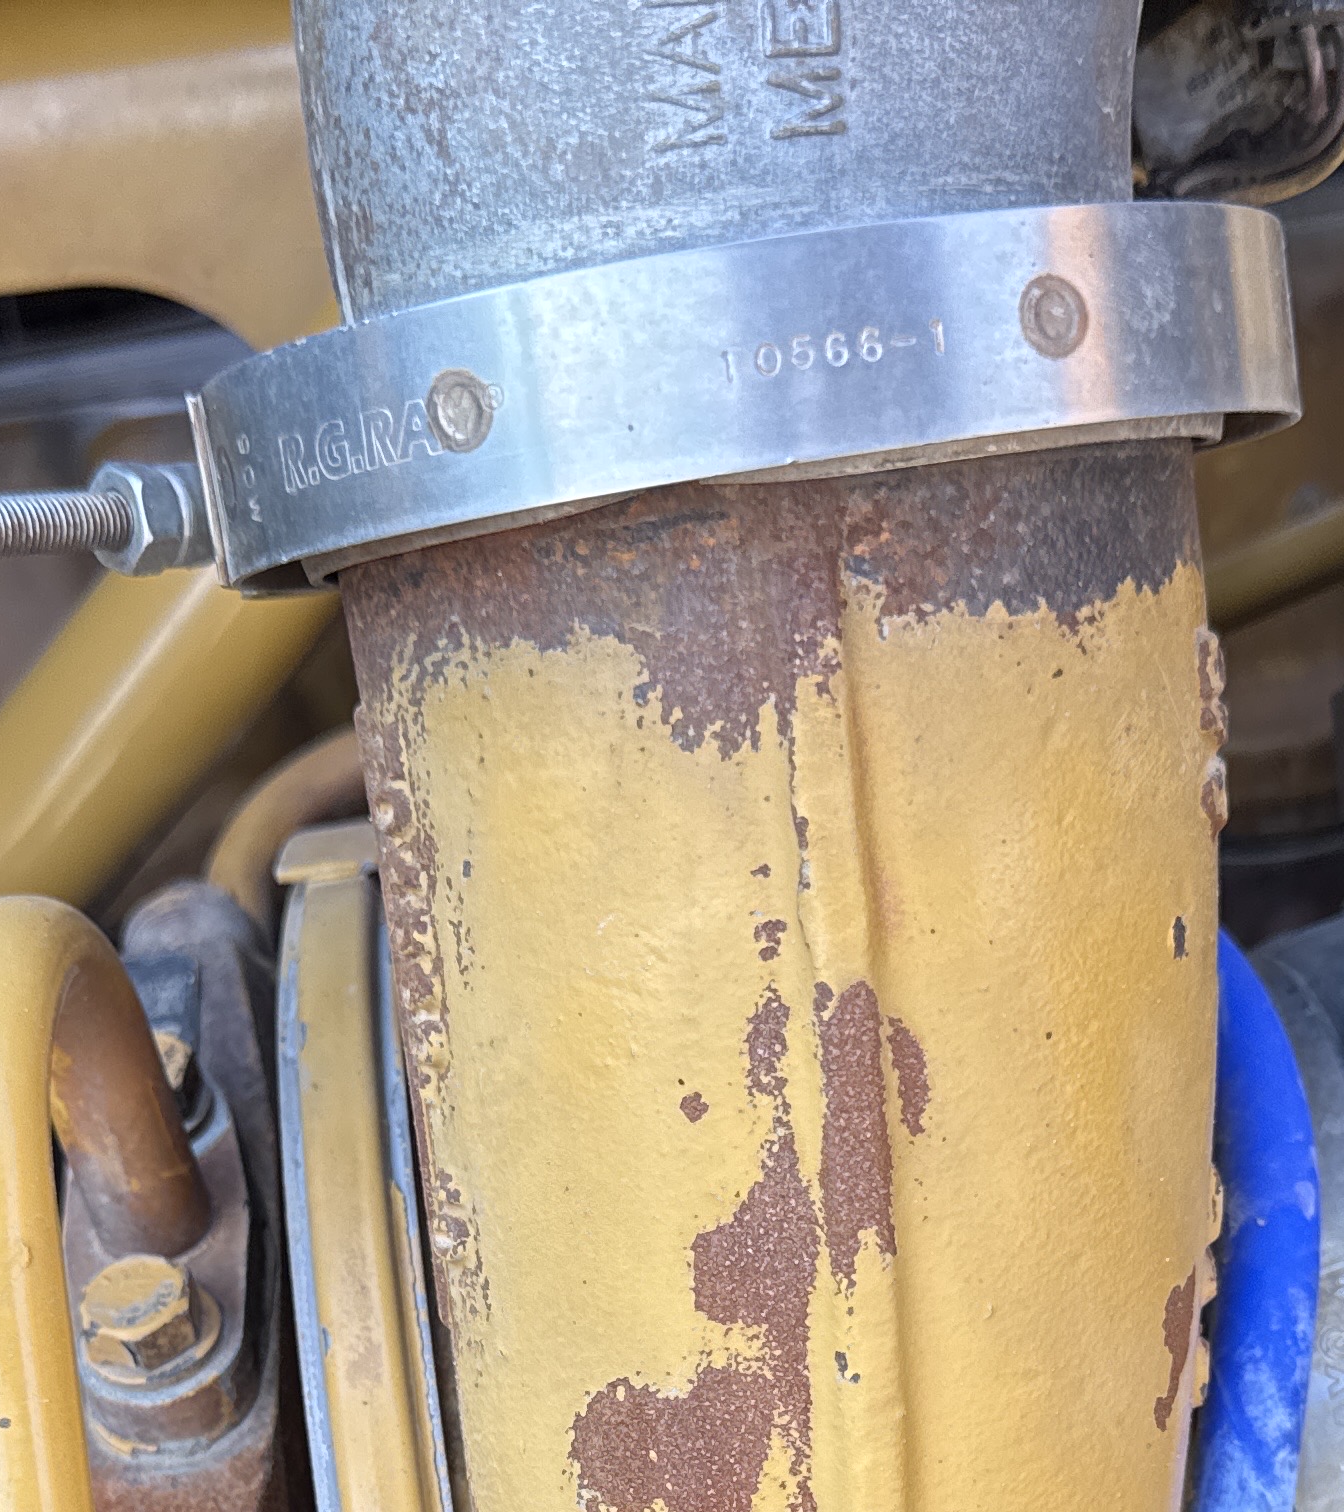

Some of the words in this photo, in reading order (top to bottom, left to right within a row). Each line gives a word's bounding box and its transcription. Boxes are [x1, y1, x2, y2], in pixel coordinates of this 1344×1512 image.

[643, 0, 727, 151] MA
[719, 317, 945, 384] 10566-1
[277, 397, 445, 496] R.G.RA
